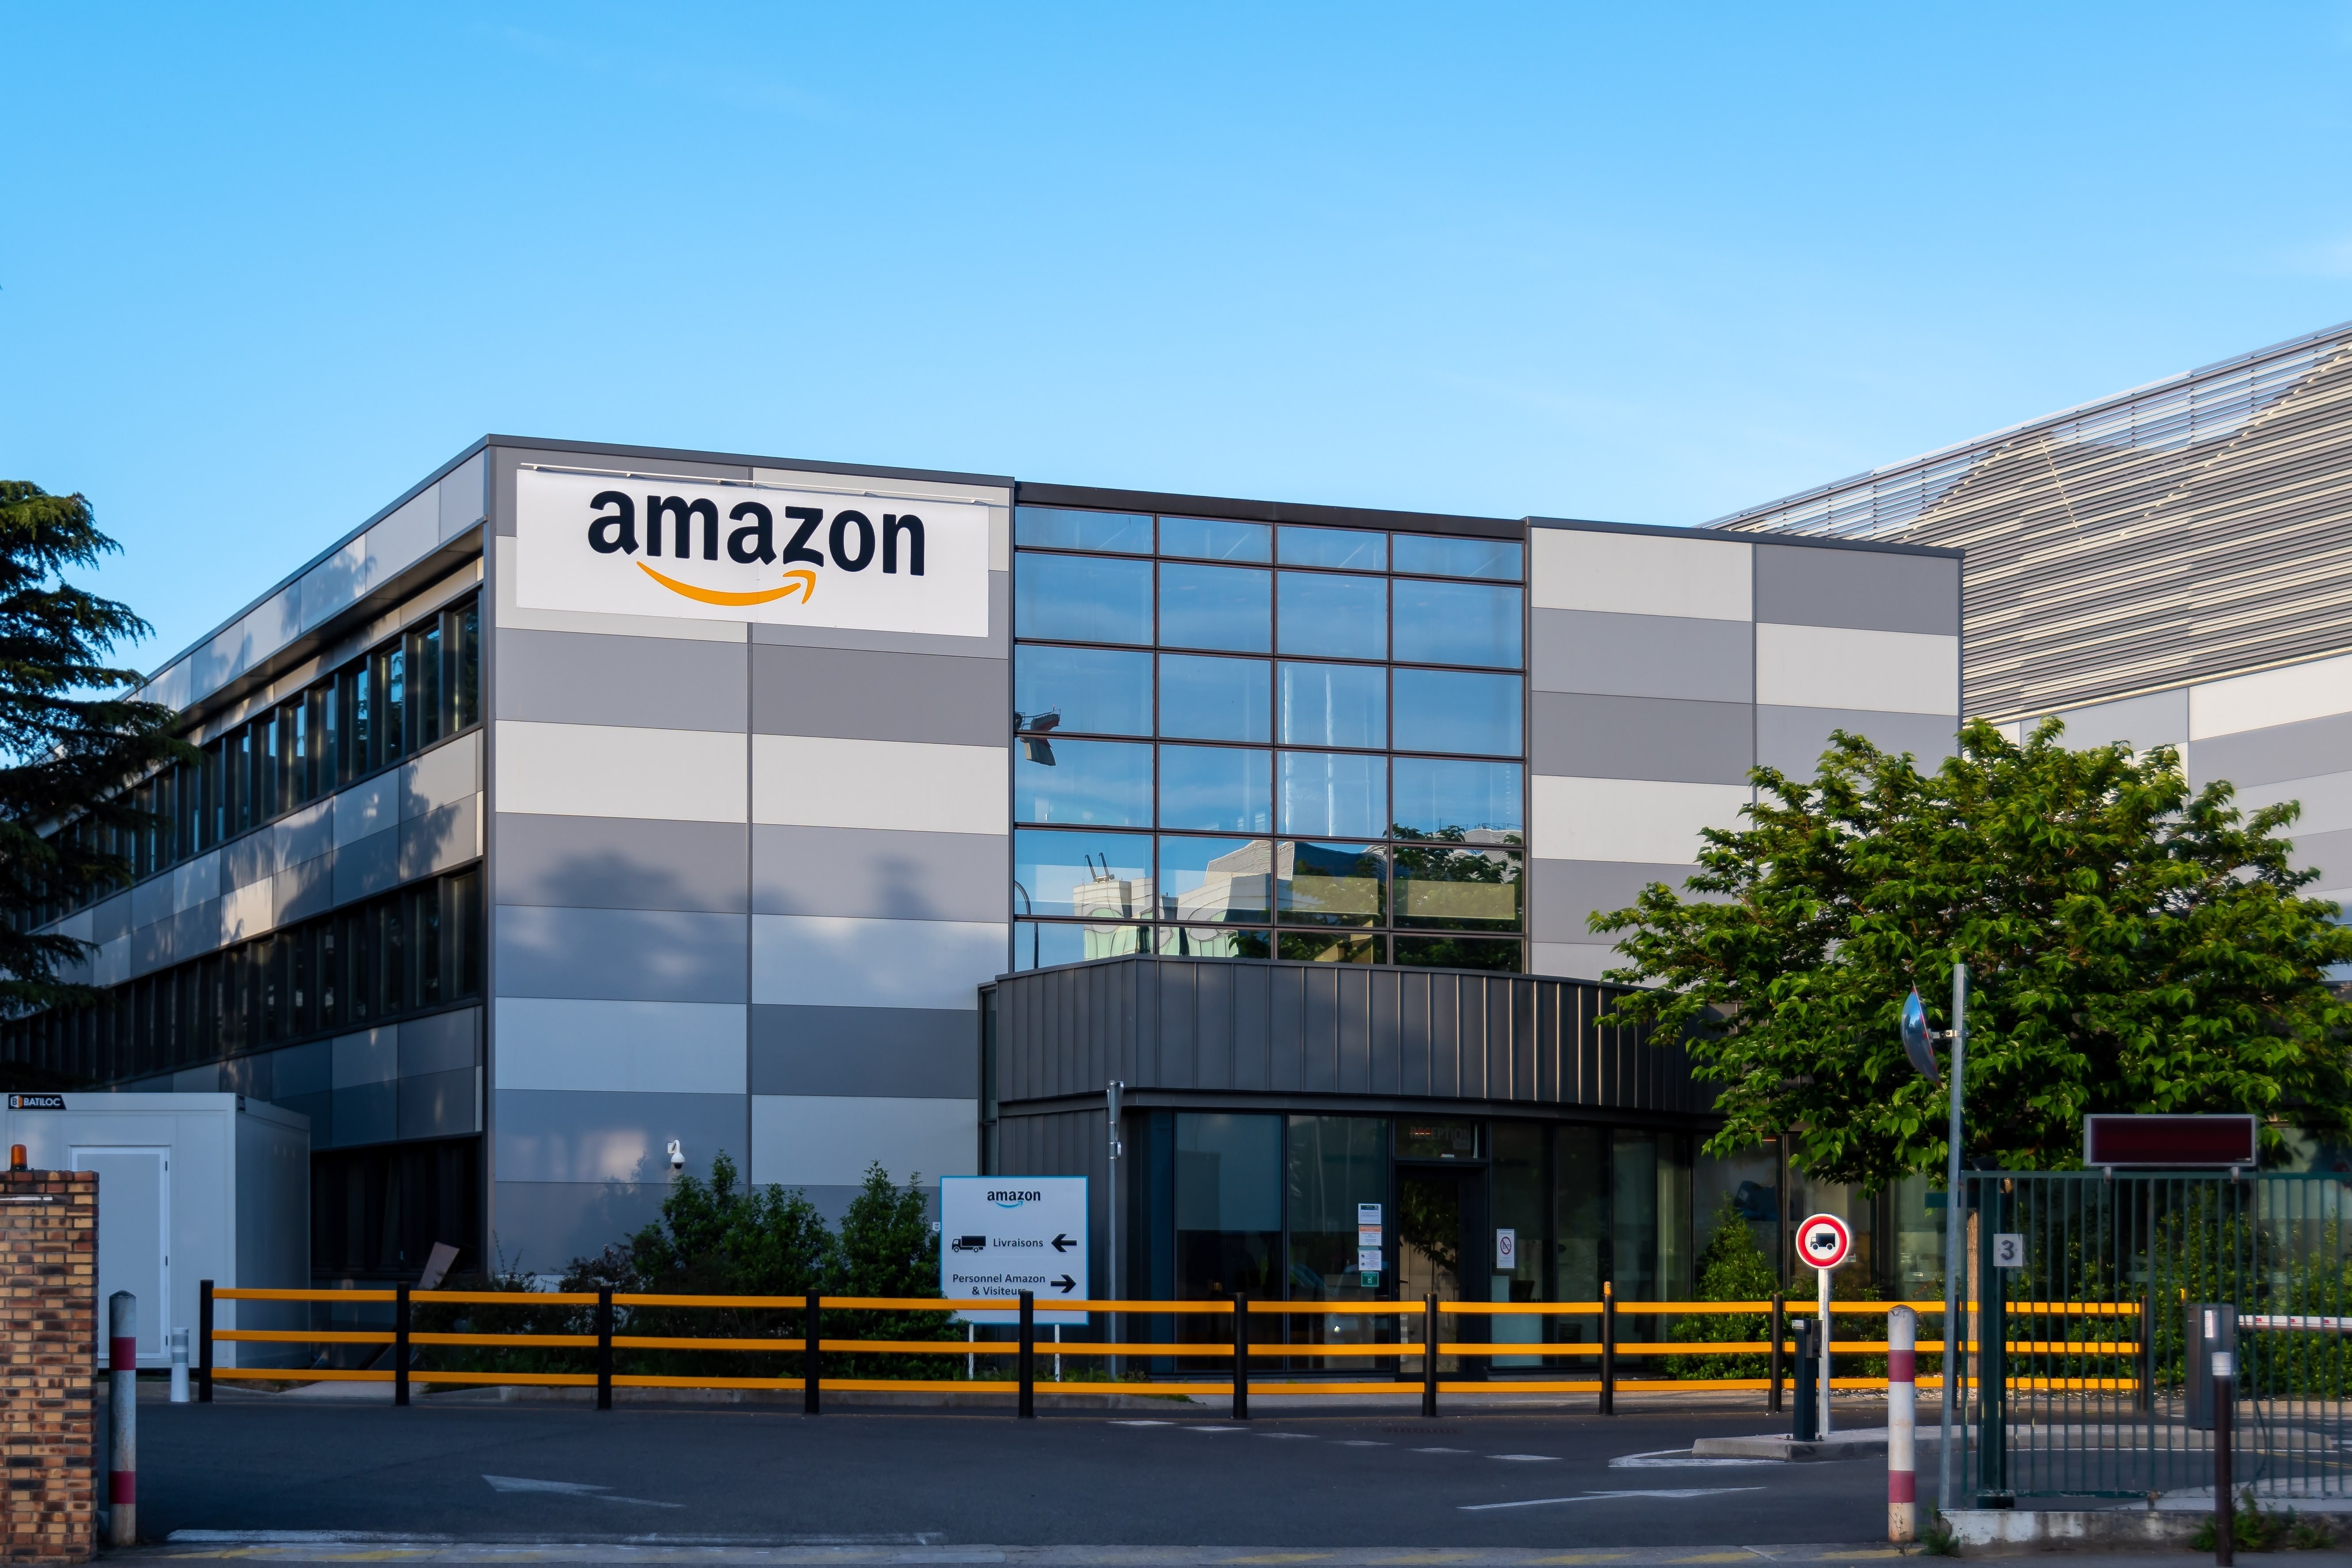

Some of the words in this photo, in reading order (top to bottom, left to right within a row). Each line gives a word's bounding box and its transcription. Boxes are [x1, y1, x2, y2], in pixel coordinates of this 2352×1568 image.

[588, 490, 925, 576] amazon
[987, 1190, 1041, 1201] amazon
[993, 1238, 1043, 1247] Livraisons
[2000, 1240, 2014, 1261] 3
[953, 1274, 1002, 1283] Personnel
[1005, 1274, 1046, 1283] Amazon
[972, 1286, 980, 1295] &
